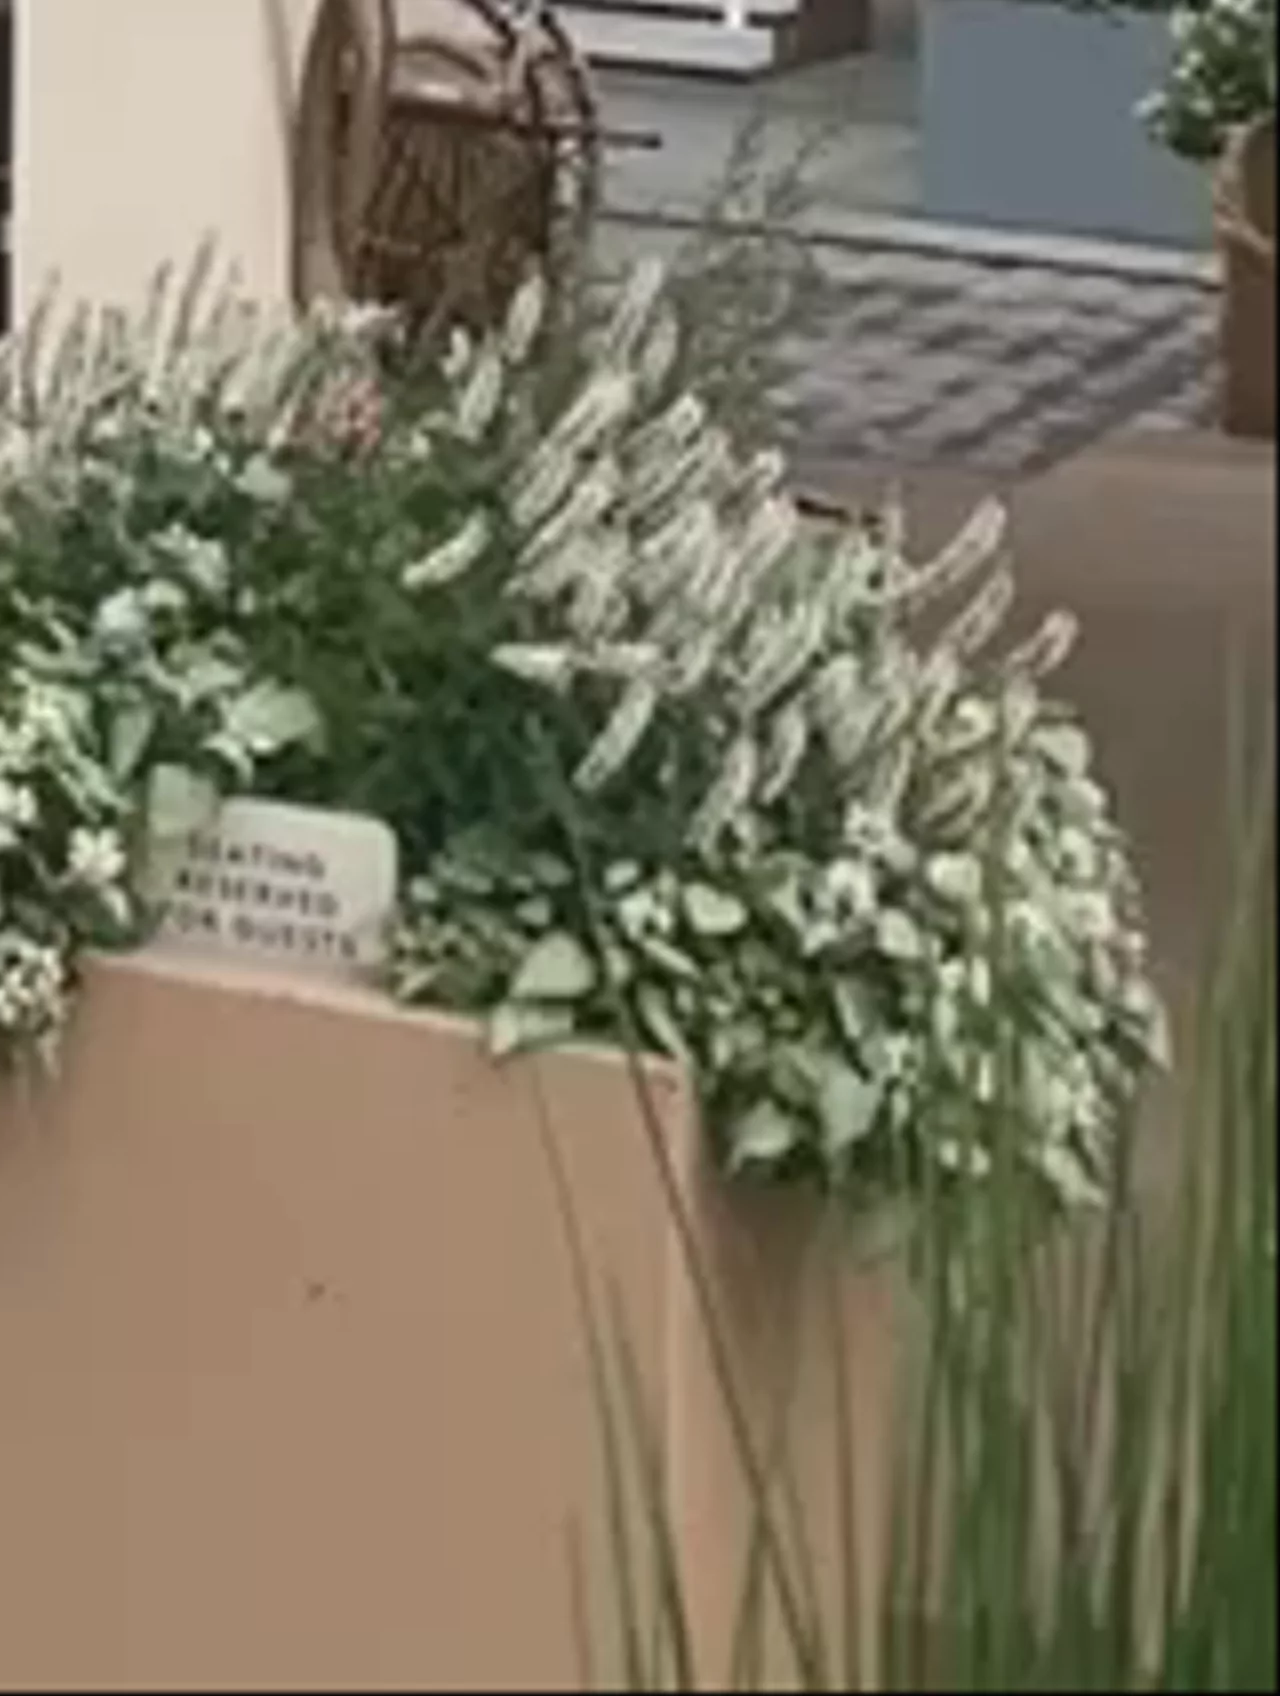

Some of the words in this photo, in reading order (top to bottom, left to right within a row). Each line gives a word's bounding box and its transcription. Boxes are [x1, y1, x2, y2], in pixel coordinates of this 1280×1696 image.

[187, 830, 327, 882] SEATING
[174, 867, 341, 920] RESERVED
[230, 913, 359, 960] GUESTS
